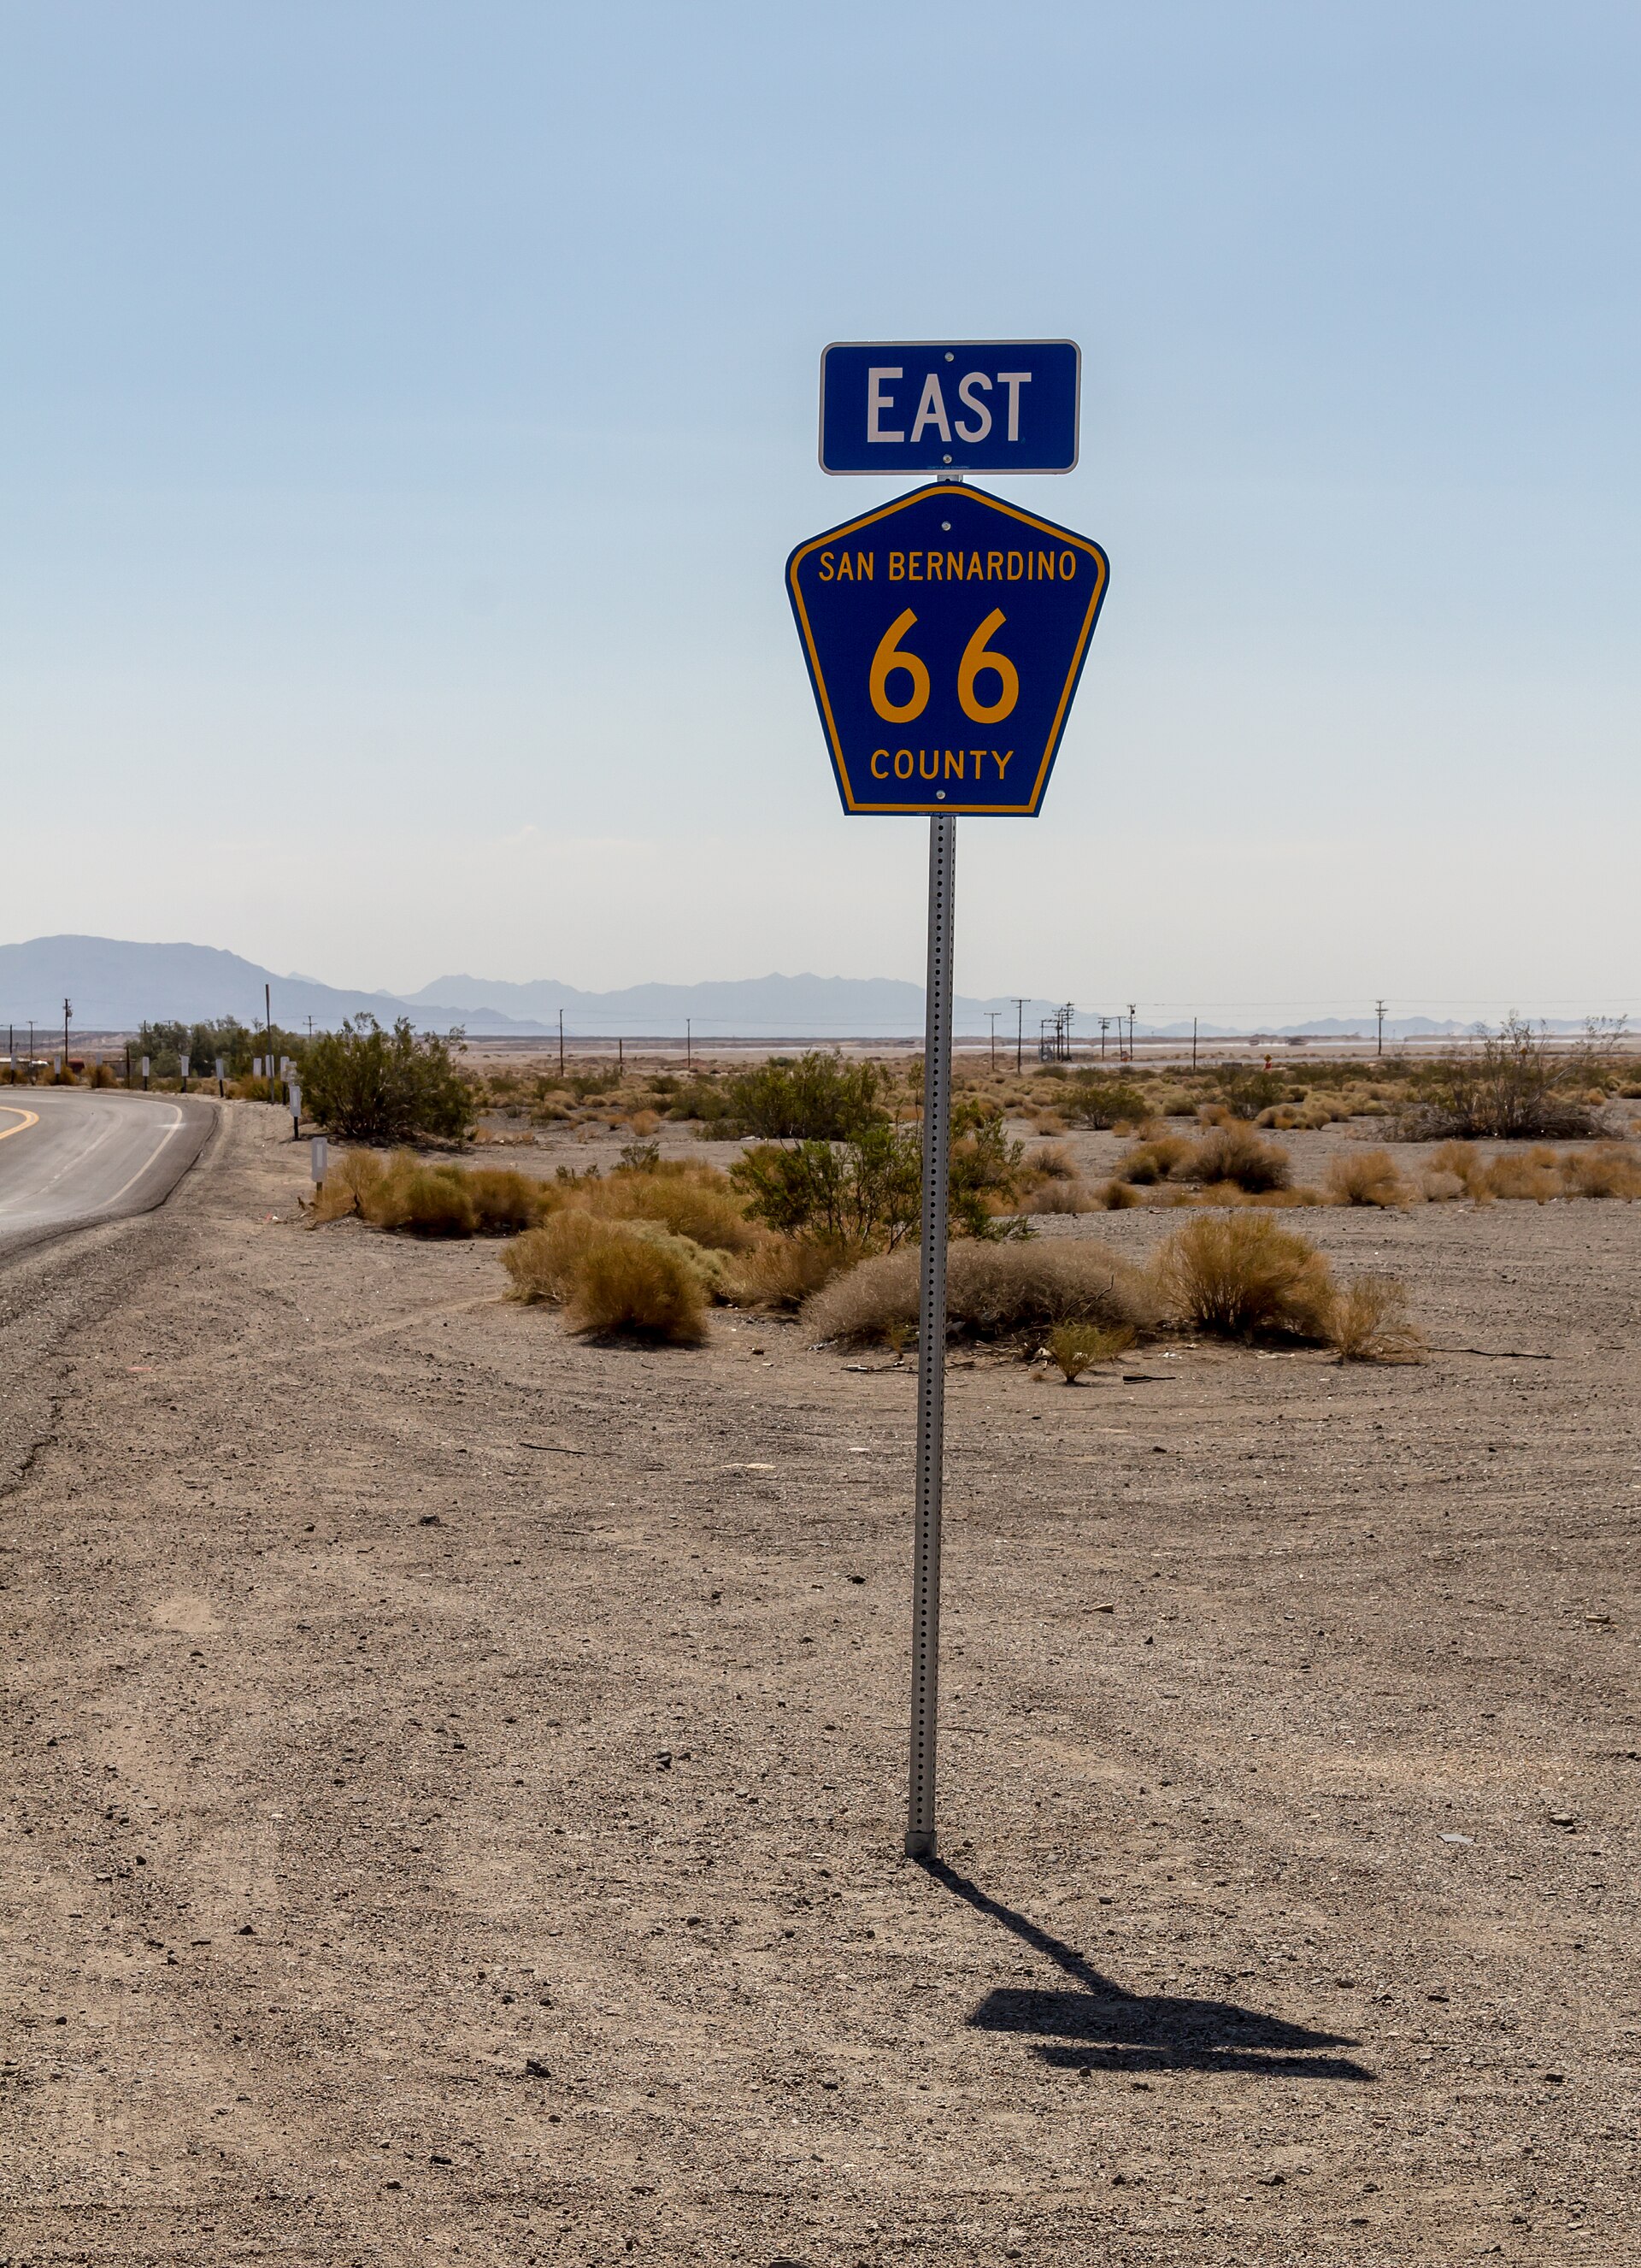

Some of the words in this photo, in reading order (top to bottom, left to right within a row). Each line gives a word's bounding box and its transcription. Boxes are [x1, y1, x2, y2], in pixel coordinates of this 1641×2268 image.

[867, 367, 1032, 443] EAST
[819, 551, 873, 581] SAN
[889, 551, 1076, 580] BERNARDINO
[868, 607, 1020, 724] 66
[870, 749, 1014, 780] COUNTY
